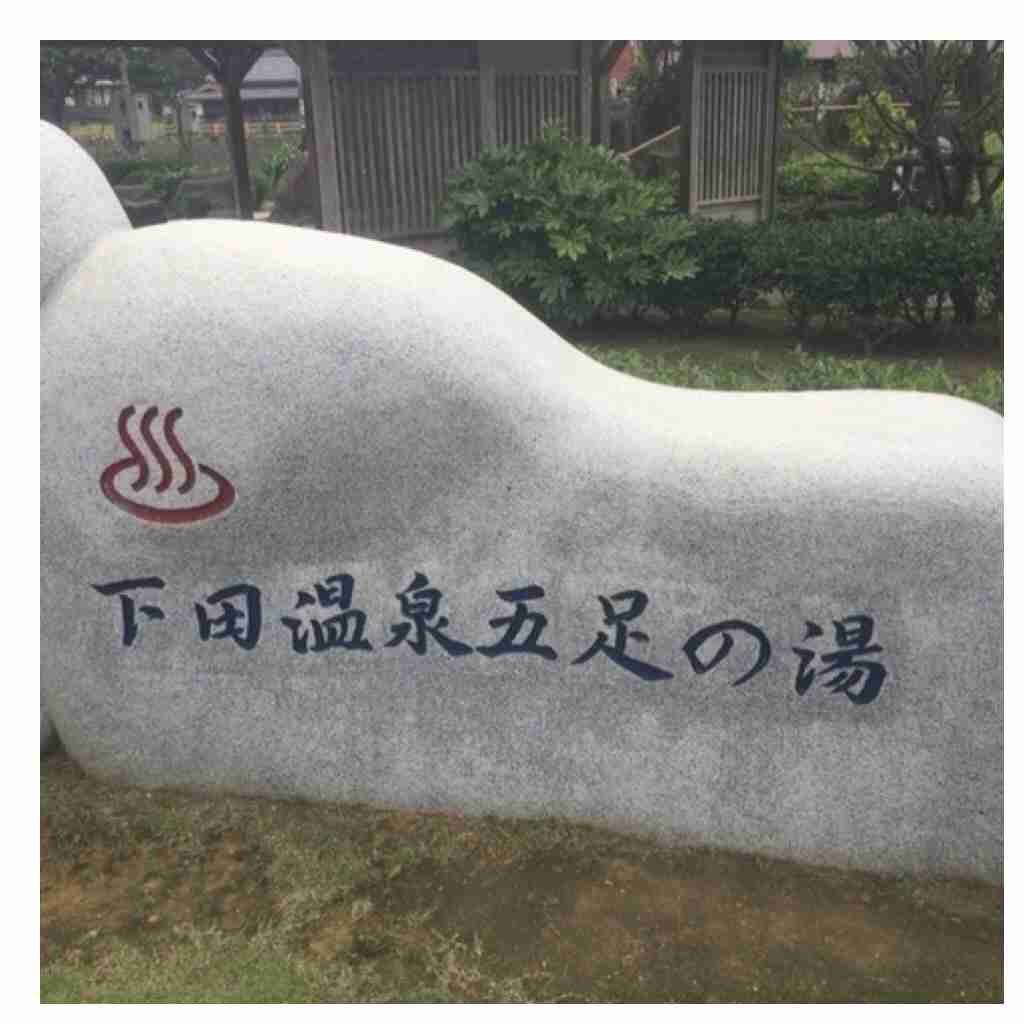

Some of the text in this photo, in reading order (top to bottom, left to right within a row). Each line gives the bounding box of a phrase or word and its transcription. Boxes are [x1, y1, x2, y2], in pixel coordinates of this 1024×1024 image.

[91, 572, 888, 705] 下田温泉五足の湯
